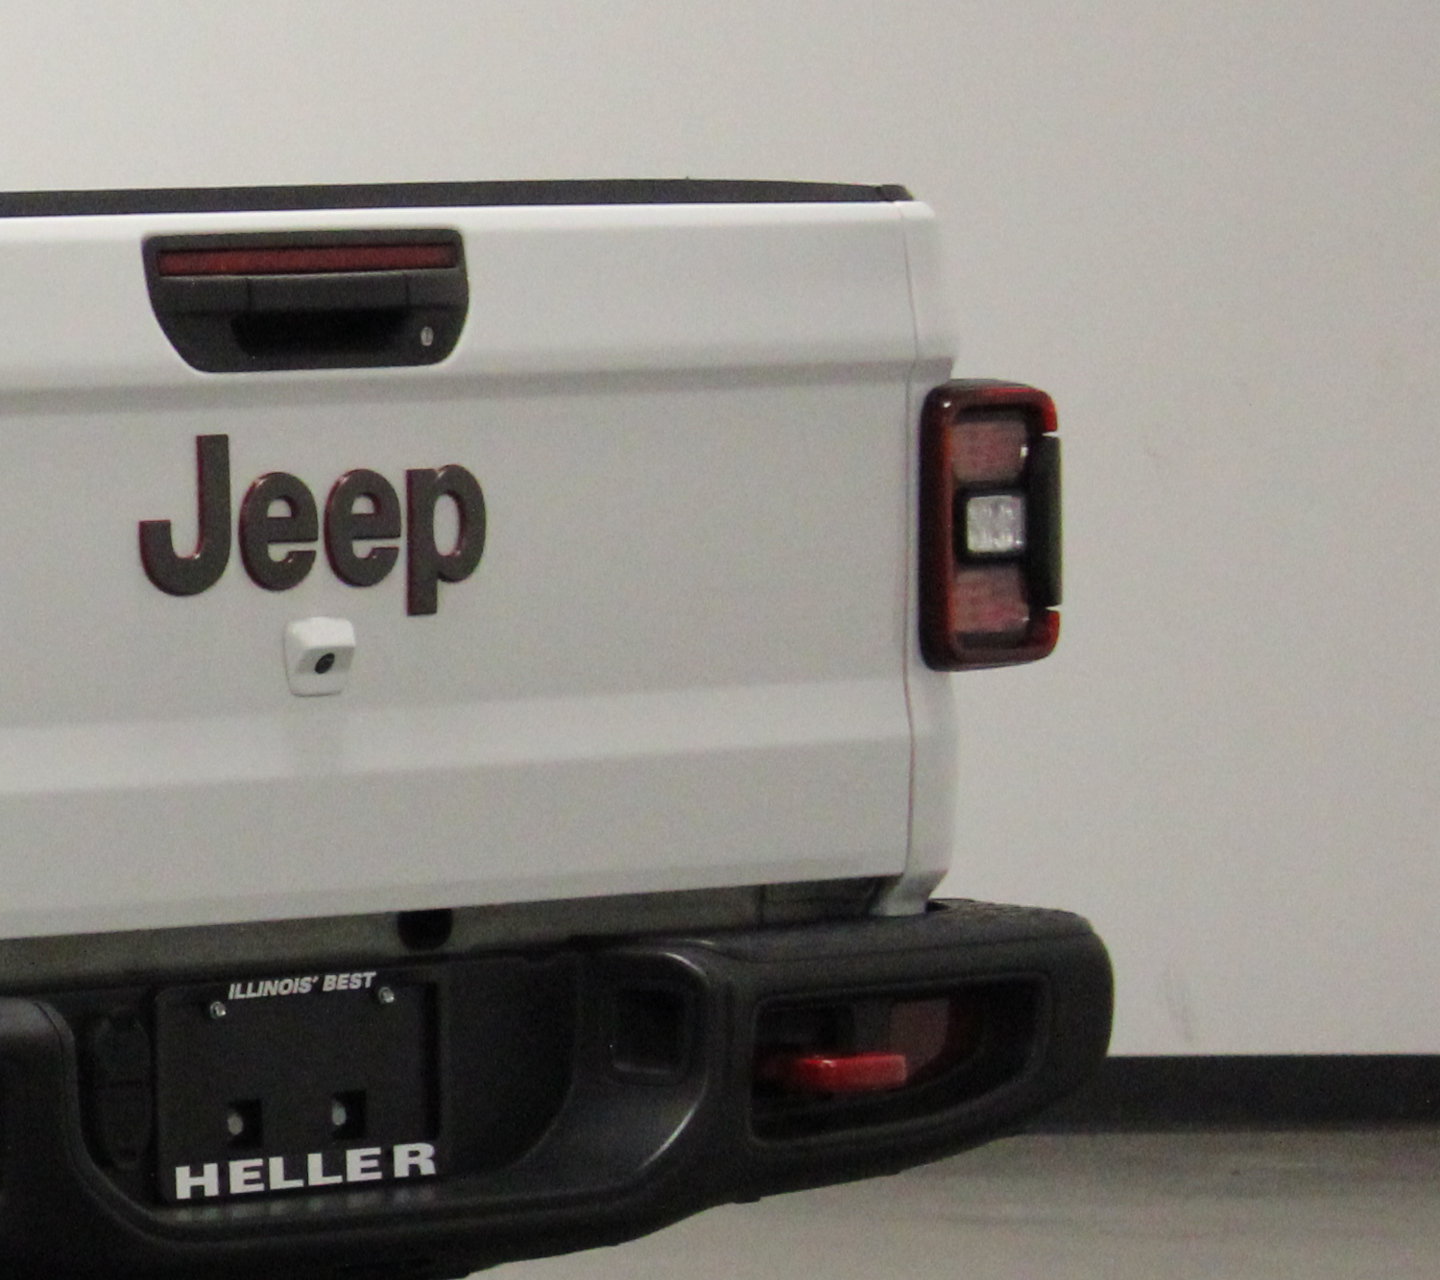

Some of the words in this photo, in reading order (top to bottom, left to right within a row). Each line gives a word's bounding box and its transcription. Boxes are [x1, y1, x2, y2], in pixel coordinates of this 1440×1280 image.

[138, 433, 487, 617] Jeep
[322, 972, 377, 991] BEST
[175, 1142, 436, 1200] HELLER
